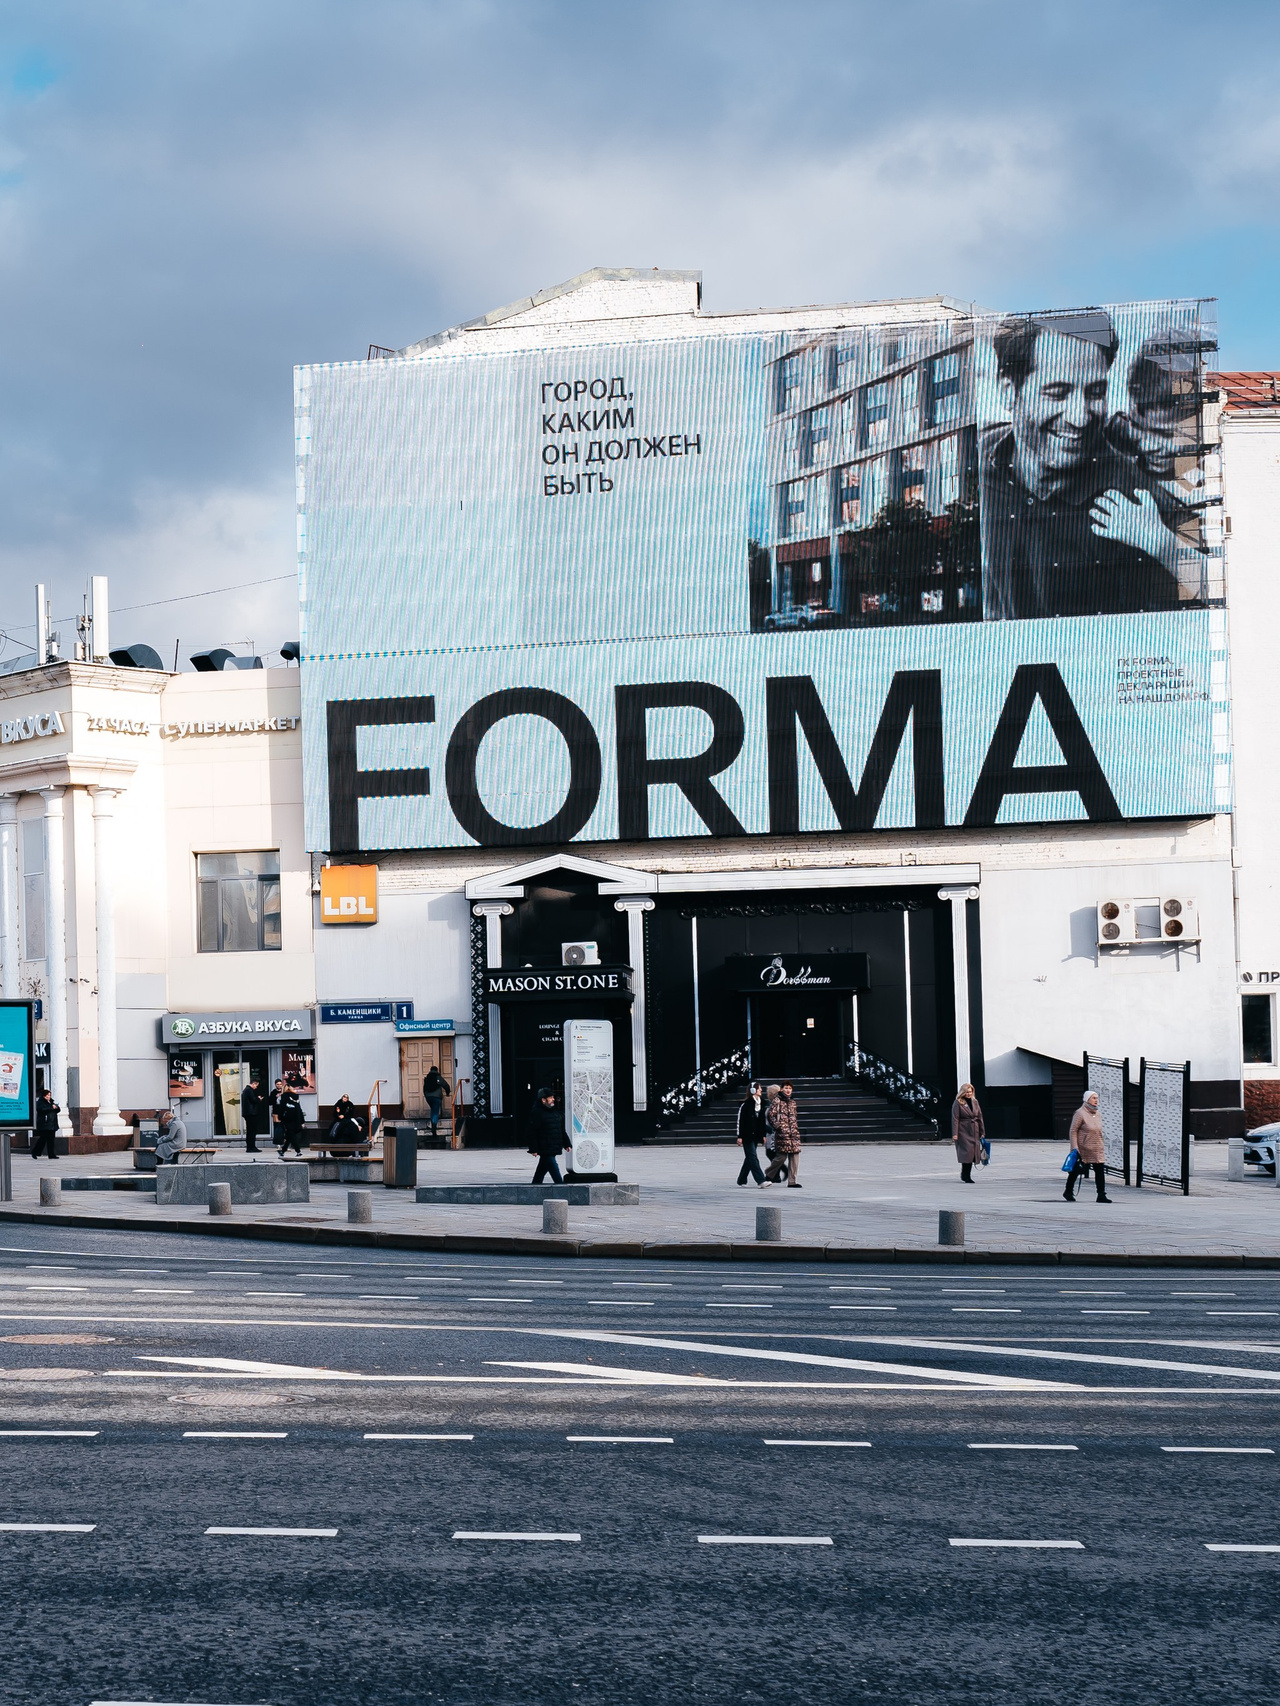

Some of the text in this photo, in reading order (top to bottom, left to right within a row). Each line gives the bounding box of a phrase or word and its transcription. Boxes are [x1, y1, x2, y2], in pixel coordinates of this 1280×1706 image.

[541, 376, 634, 403] ГОРОД,
[542, 407, 635, 434] КАКИМ
[542, 434, 701, 466] ОН ДОЛЖЕН
[544, 472, 614, 496] БЫТЬ
[1117, 658, 1130, 667] ГК
[1117, 668, 1184, 680] ПРОЕКТНЫЕ
[1117, 679, 1194, 693] ДЕКЛАРАЦИИ
[1118, 695, 1135, 705] НА
[0, 711, 66, 744] ВКУСА
[163, 715, 301, 738] СУПЕРМАРКЕТ
[325, 661, 1122, 852] FORMA
[323, 896, 374, 916] LBL
[488, 976, 551, 992] MASON
[337, 1007, 382, 1016] КАМЕНЩИКИ
[401, 1005, 407, 1018] 1
[198, 1019, 302, 1034] АЗБУКА ВКУСА
[399, 1022, 451, 1031] Офисный центр
